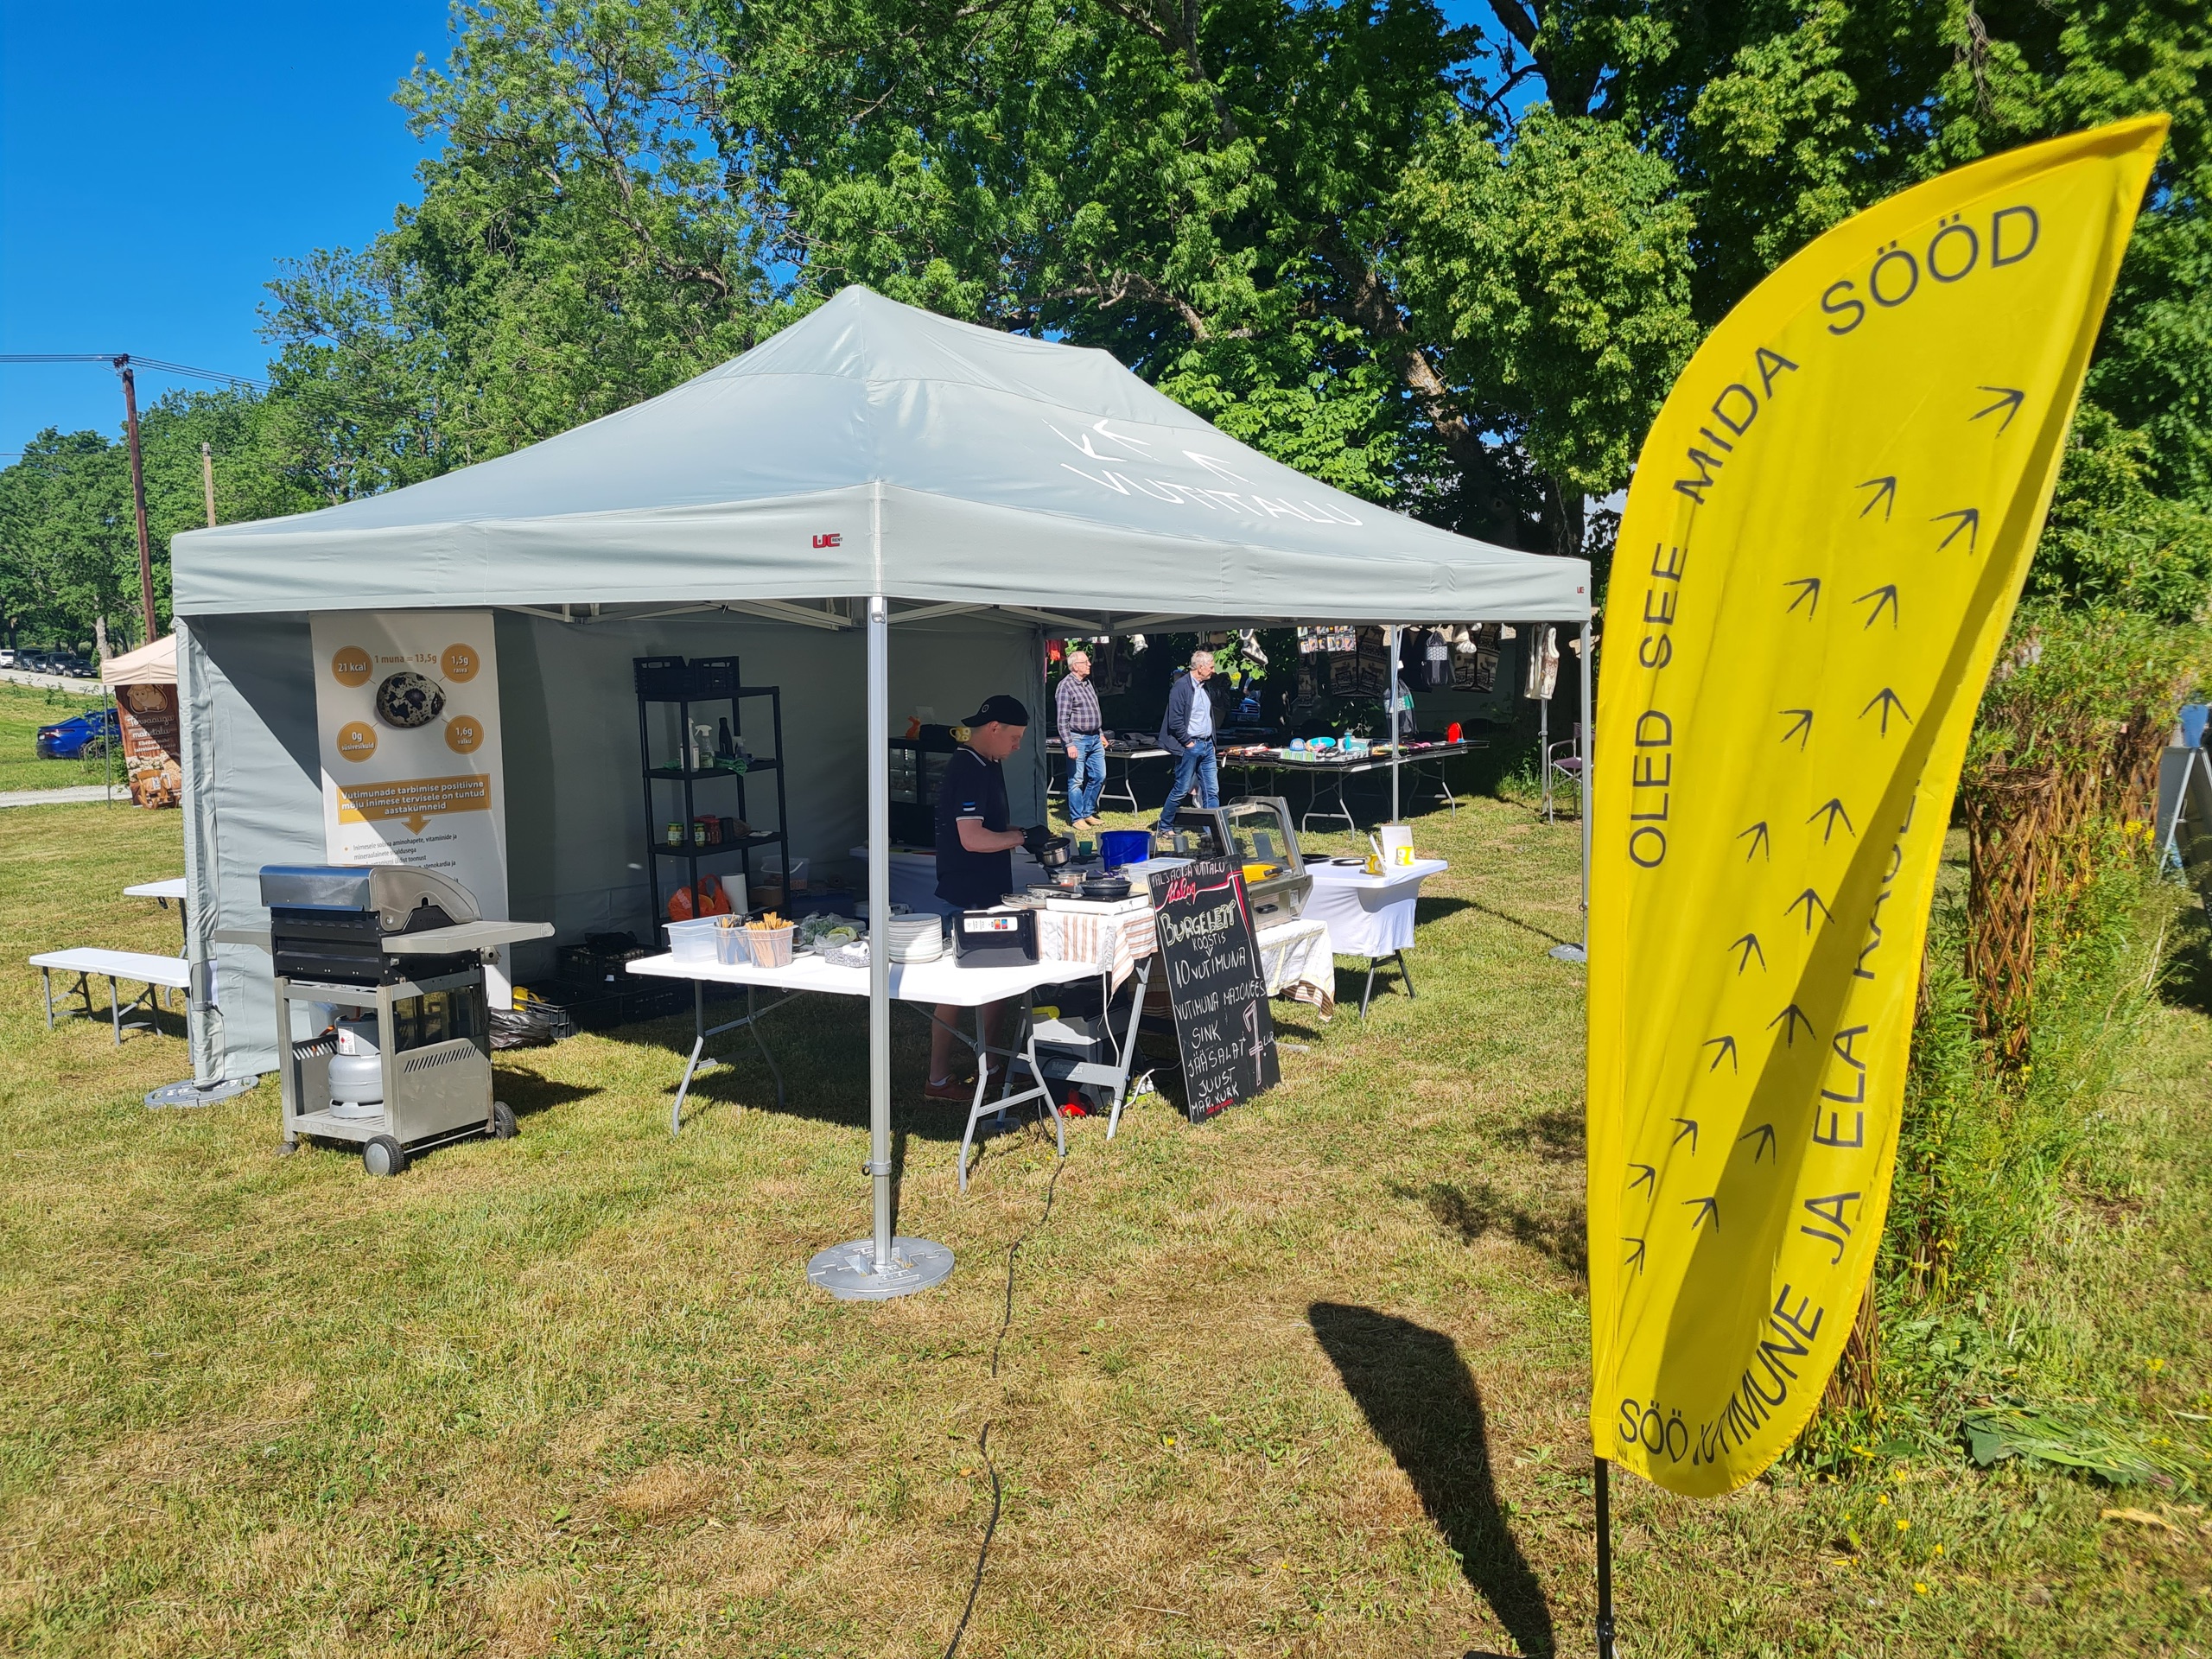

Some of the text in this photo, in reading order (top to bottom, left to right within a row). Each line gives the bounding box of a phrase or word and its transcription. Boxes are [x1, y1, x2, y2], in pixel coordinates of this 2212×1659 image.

[1060, 462, 1363, 526] VUTITALU
[1630, 205, 2040, 868] OLED SEE MIDA SÖÖD
[338, 662, 366, 672] 21 kcal
[374, 655, 378, 664] 1
[451, 656, 469, 666] 1,5g
[352, 732, 363, 742] 0g
[455, 727, 473, 737] 1,6g
[341, 780, 484, 800] Vutimunade tarbimise positiivne
[366, 798, 400, 808] inimese
[402, 793, 440, 804] tervisele
[455, 789, 485, 799] tuntud
[385, 801, 447, 815] aastakümneid
[1192, 931, 1227, 951] KOOSTIS
[1175, 959, 1190, 988] 10
[1175, 979, 1267, 1020] VUTIMUNA MAJONEES
[1192, 1020, 1222, 1049] SINK
[1198, 1066, 1236, 1097] JUUST
[1214, 1081, 1240, 1105] KURK
[1813, 1024, 1869, 1148] ELA
[1800, 1192, 1861, 1265] JA
[1618, 1398, 1688, 1464] SÖÖ
